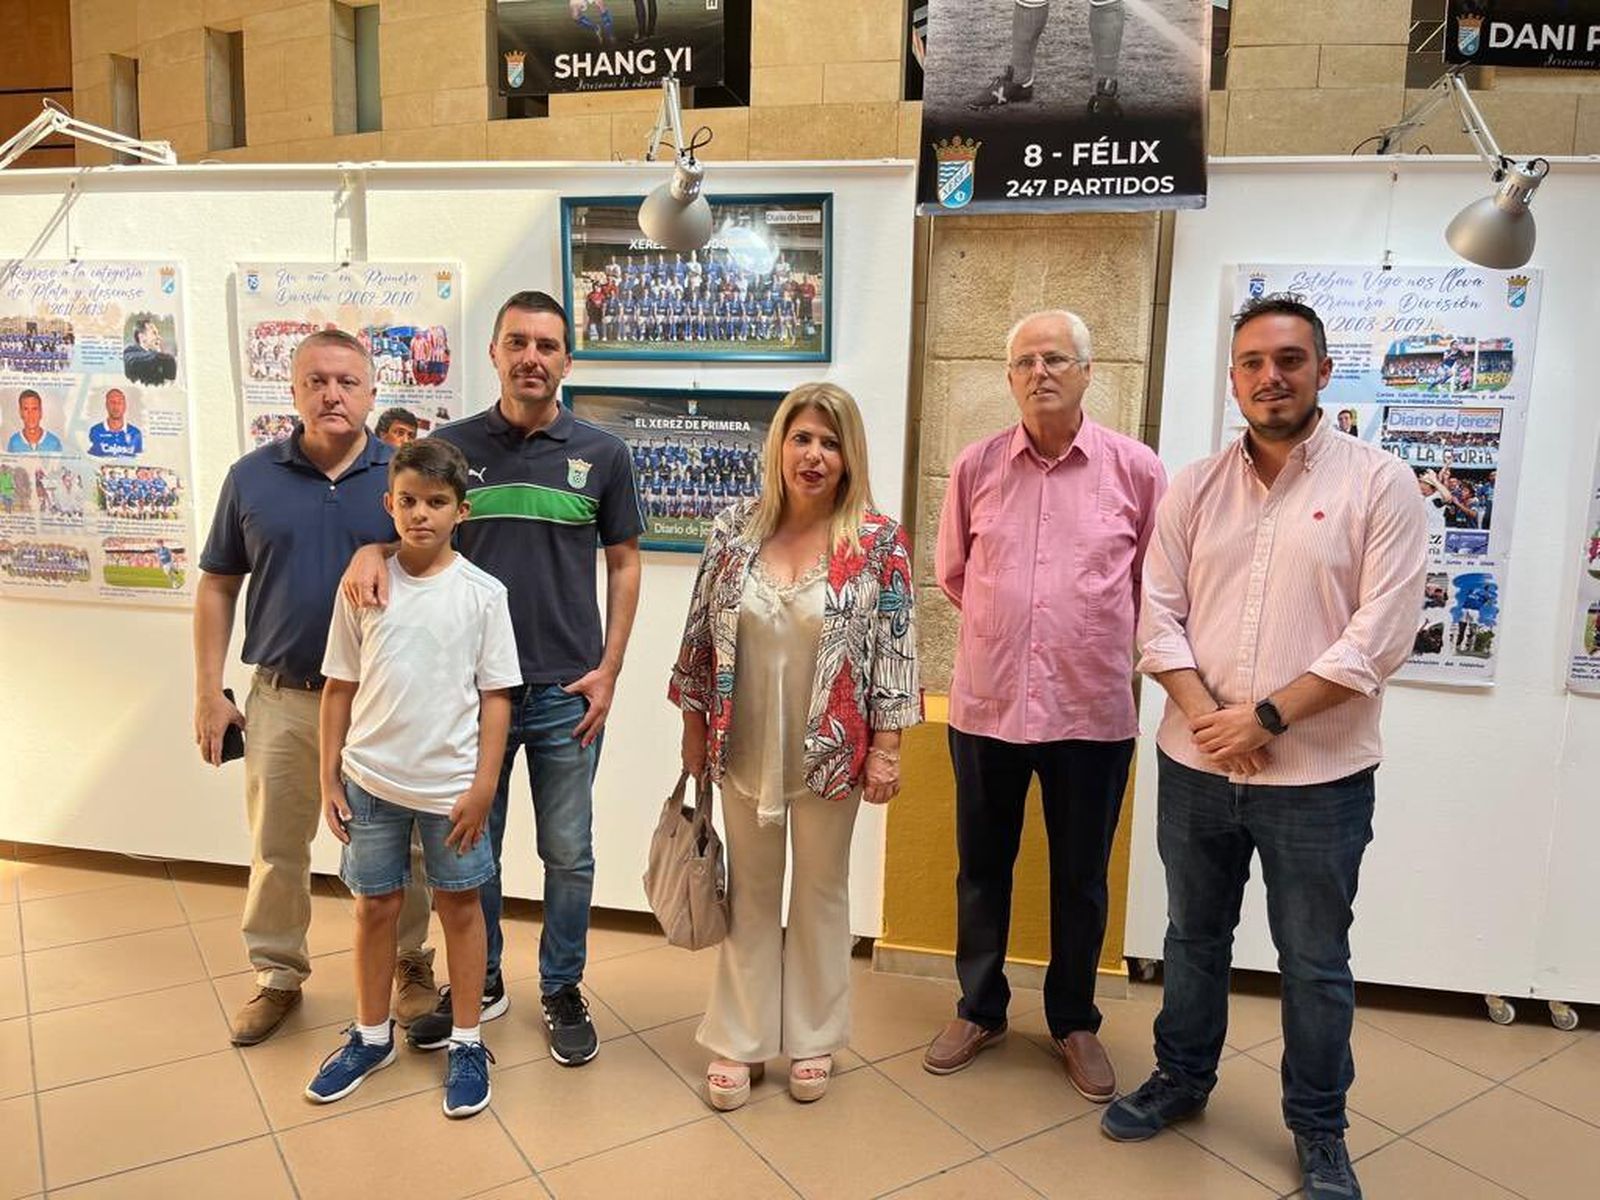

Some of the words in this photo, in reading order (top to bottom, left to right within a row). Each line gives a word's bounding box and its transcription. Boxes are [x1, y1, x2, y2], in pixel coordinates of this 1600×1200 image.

[1489, 22, 1576, 51] DANI
[554, 50, 656, 79] SHANG
[664, 46, 692, 73] YI
[1023, 144, 1043, 168] 8
[1072, 136, 1161, 166] FÉLIX
[1006, 180, 1047, 197] 247
[1053, 176, 1175, 196] PARTIDOS
[1408, 274, 1434, 289] nos
[1439, 268, 1485, 293] lleva
[1401, 291, 1483, 314] División
[635, 418, 647, 428] EL
[648, 418, 683, 429] XEREZ
[685, 420, 699, 430] DE
[701, 420, 751, 431] PRIMERA
[1390, 411, 1434, 427] Diario
[1436, 411, 1454, 427] de
[1456, 413, 1492, 431] Jerez
[1416, 446, 1435, 463] LA
[655, 522, 683, 535] Diario
[685, 523, 699, 535] de
